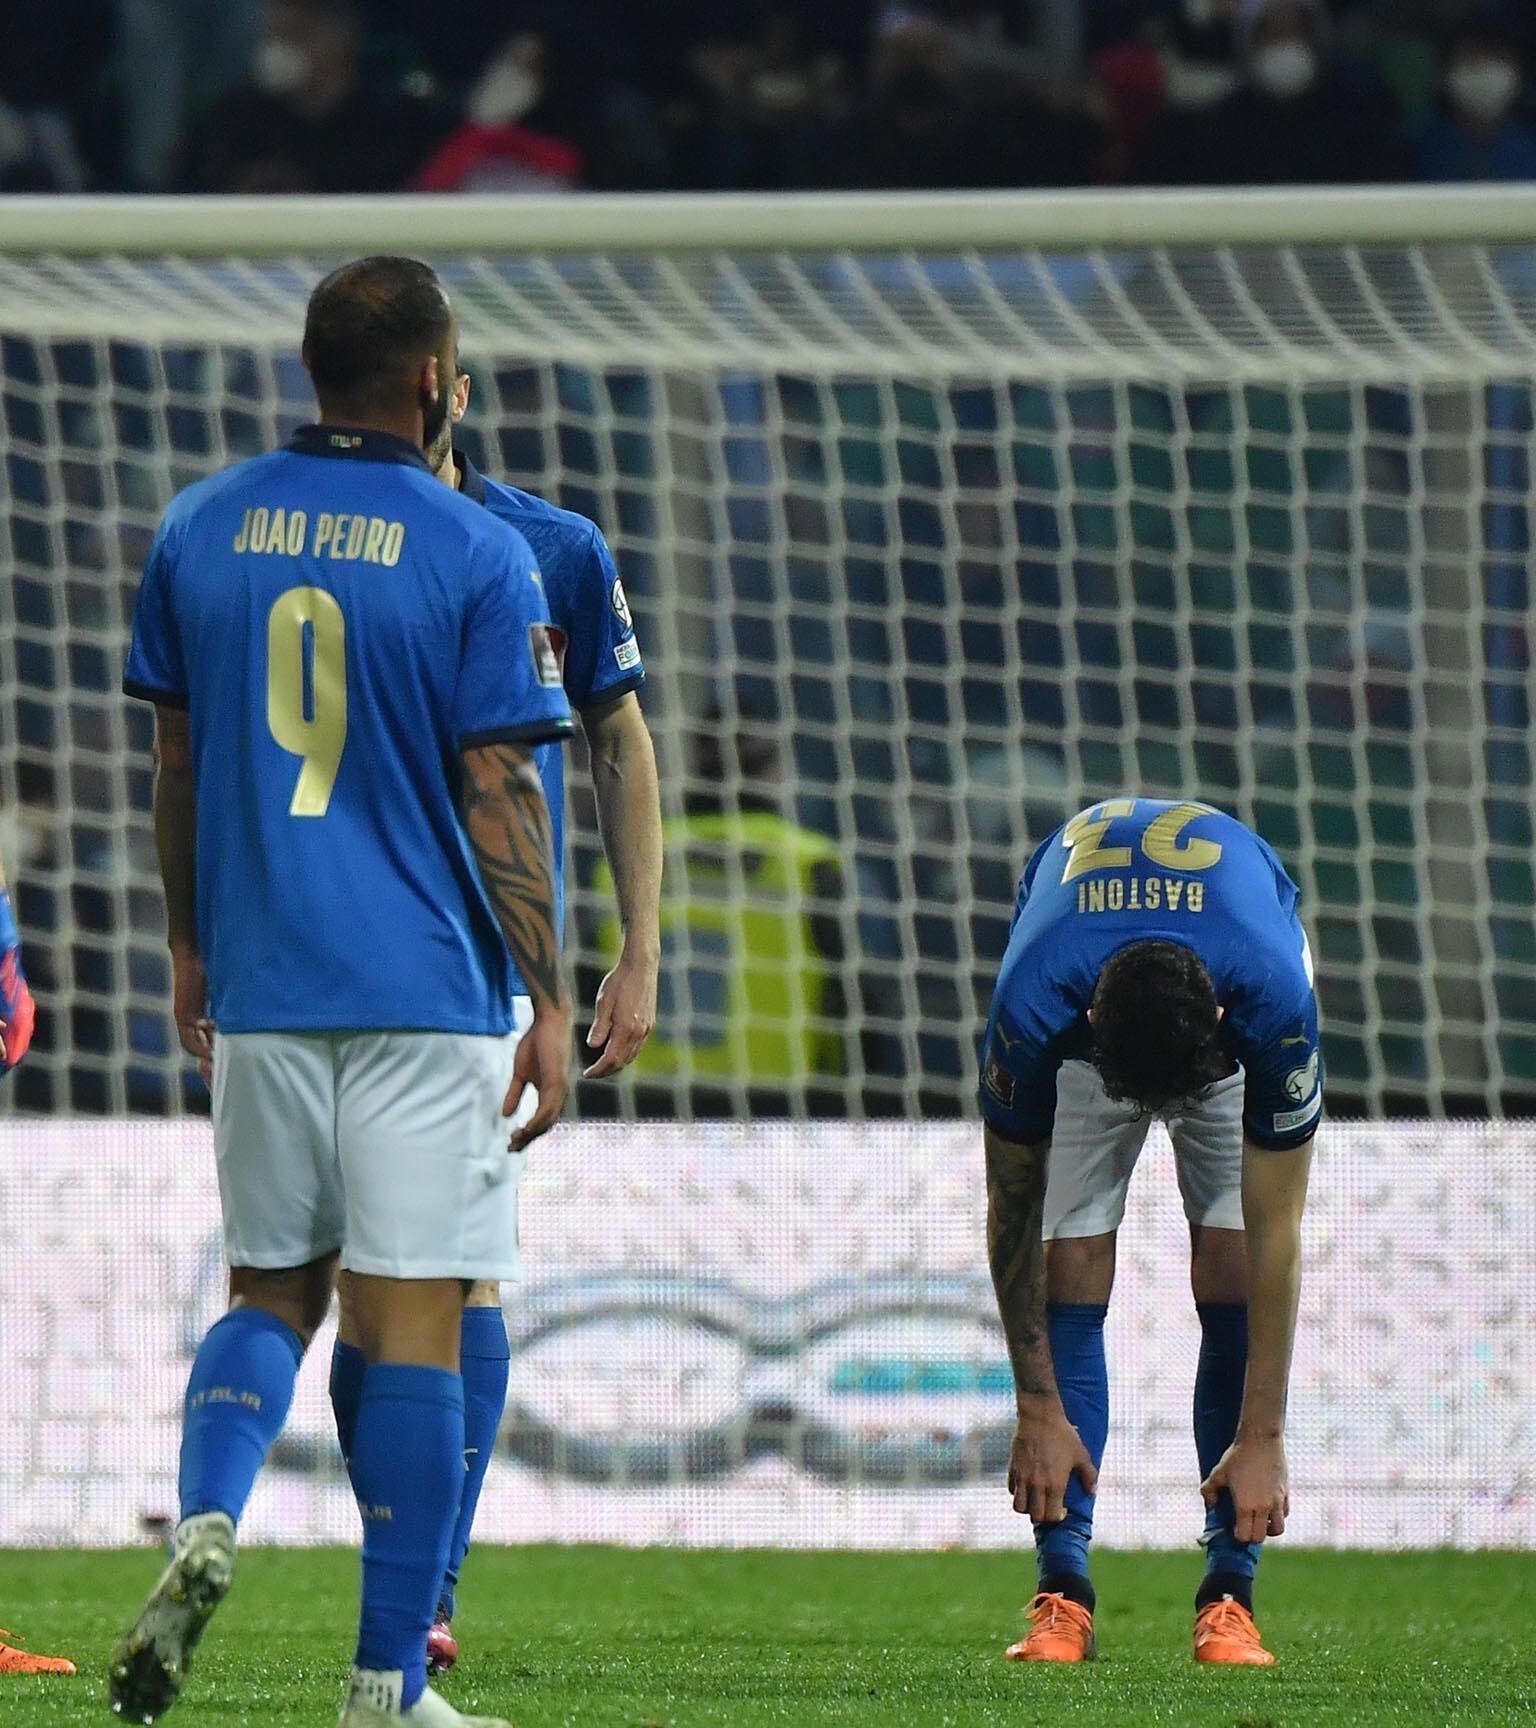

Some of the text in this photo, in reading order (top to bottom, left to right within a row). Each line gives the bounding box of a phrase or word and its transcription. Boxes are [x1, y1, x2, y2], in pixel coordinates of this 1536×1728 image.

[234, 507, 405, 567] JOAO PEDRO
[268, 586, 348, 817] 9
[1077, 876, 1205, 913] BASTONI
